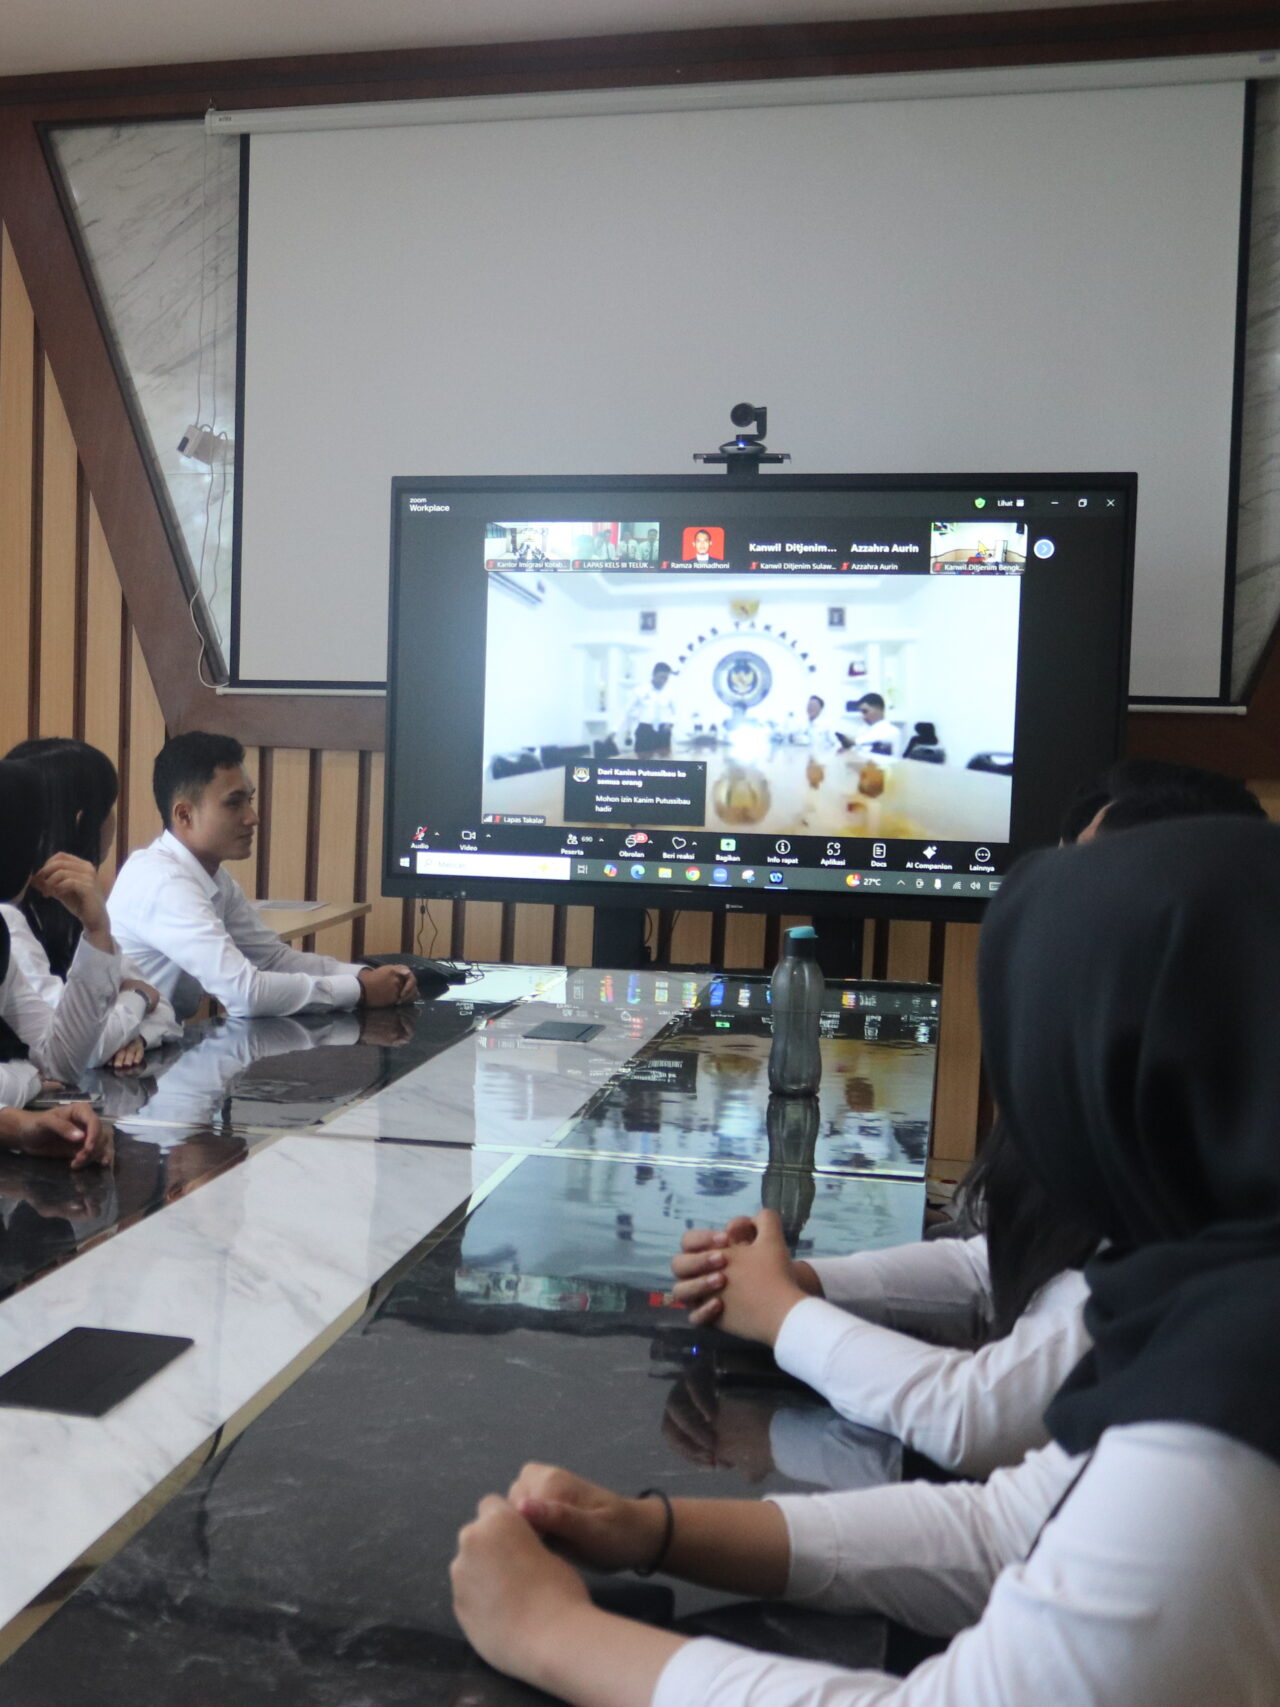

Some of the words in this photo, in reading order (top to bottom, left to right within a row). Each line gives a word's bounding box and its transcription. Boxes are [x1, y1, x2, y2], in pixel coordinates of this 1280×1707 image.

[997, 499, 1014, 507] Lihat
[409, 504, 450, 513] Workplace
[749, 542, 782, 552] Kanwil
[851, 543, 890, 553] Azzahra
[891, 544, 919, 553] Aurin
[518, 562, 543, 570] Imigrasi
[671, 561, 692, 569] Ramza
[783, 562, 811, 571] Ditjenim
[968, 564, 997, 573] Ditjenim
[597, 768, 613, 776] Dari
[614, 768, 637, 776] Kanim
[638, 769, 677, 778] Putussibau
[622, 779, 643, 788] orang
[596, 795, 620, 803] Mohon
[634, 796, 655, 804] Kanim
[656, 797, 691, 805] Putussibau
[595, 805, 613, 813] hadir
[504, 816, 522, 825] Lapas
[523, 817, 545, 825] Takalar
[561, 848, 584, 856] Peserta
[715, 854, 740, 862] Bagikan
[767, 856, 781, 864] Info
[821, 858, 845, 866] Aplikasi
[871, 860, 887, 868] Docs
[914, 862, 952, 871] Companion
[970, 864, 995, 873] Lainnya
